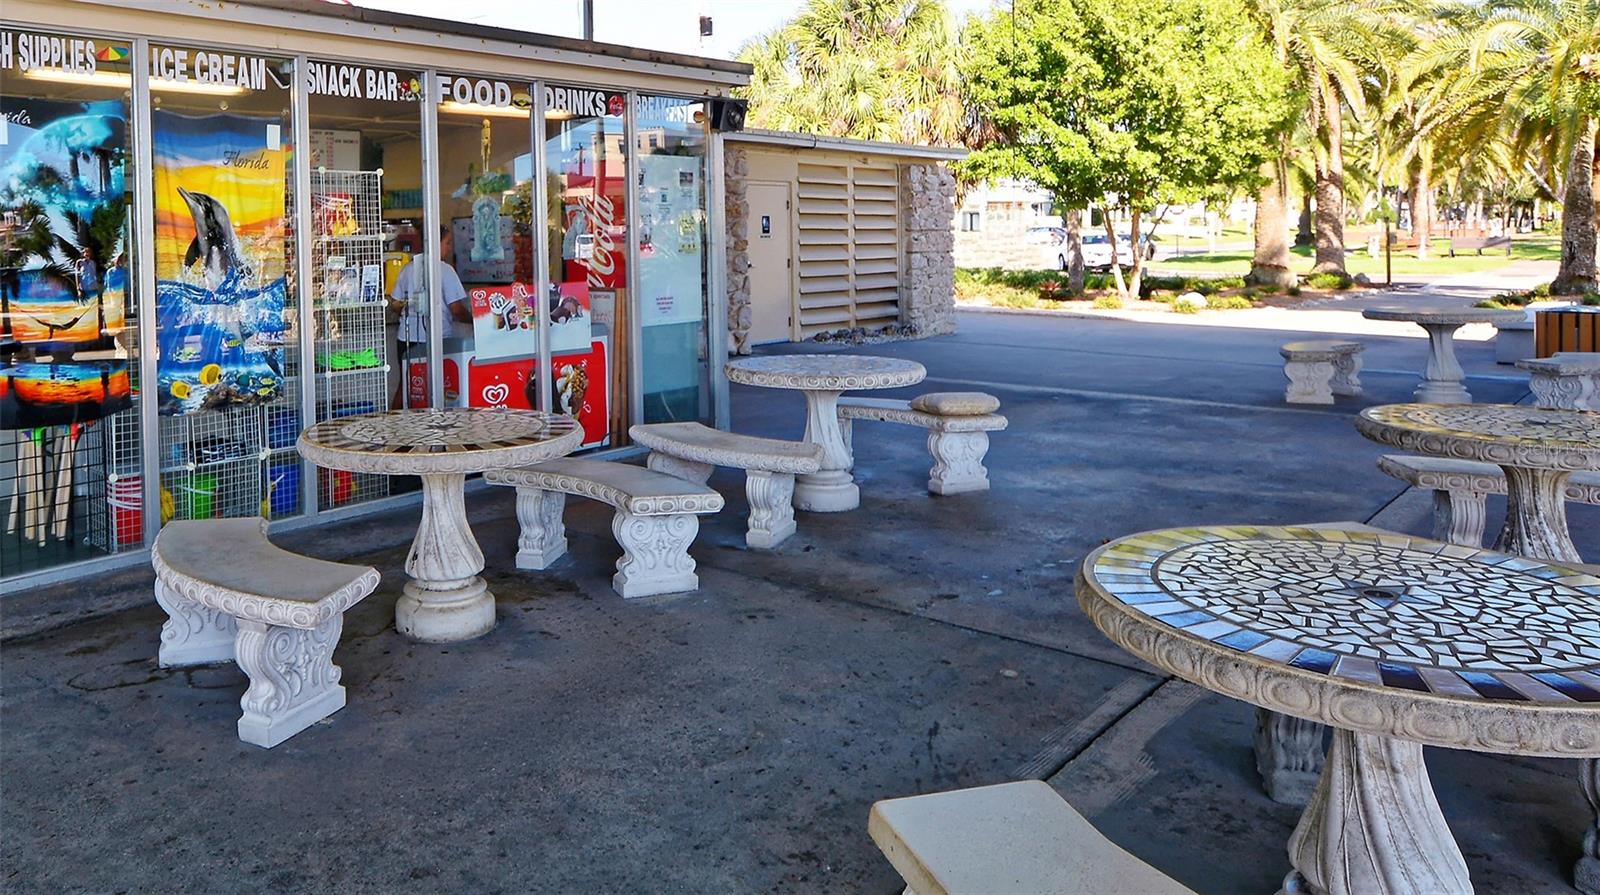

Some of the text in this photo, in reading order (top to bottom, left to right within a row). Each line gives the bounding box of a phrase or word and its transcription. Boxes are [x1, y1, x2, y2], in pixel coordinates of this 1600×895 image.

[18, 33, 96, 75] SUPPLIES
[153, 48, 267, 90] ICE CREAM
[307, 62, 398, 101] SNACK BAR
[437, 76, 512, 107] FOOD
[545, 87, 606, 117] DRINKS
[223, 150, 270, 169] Florida
